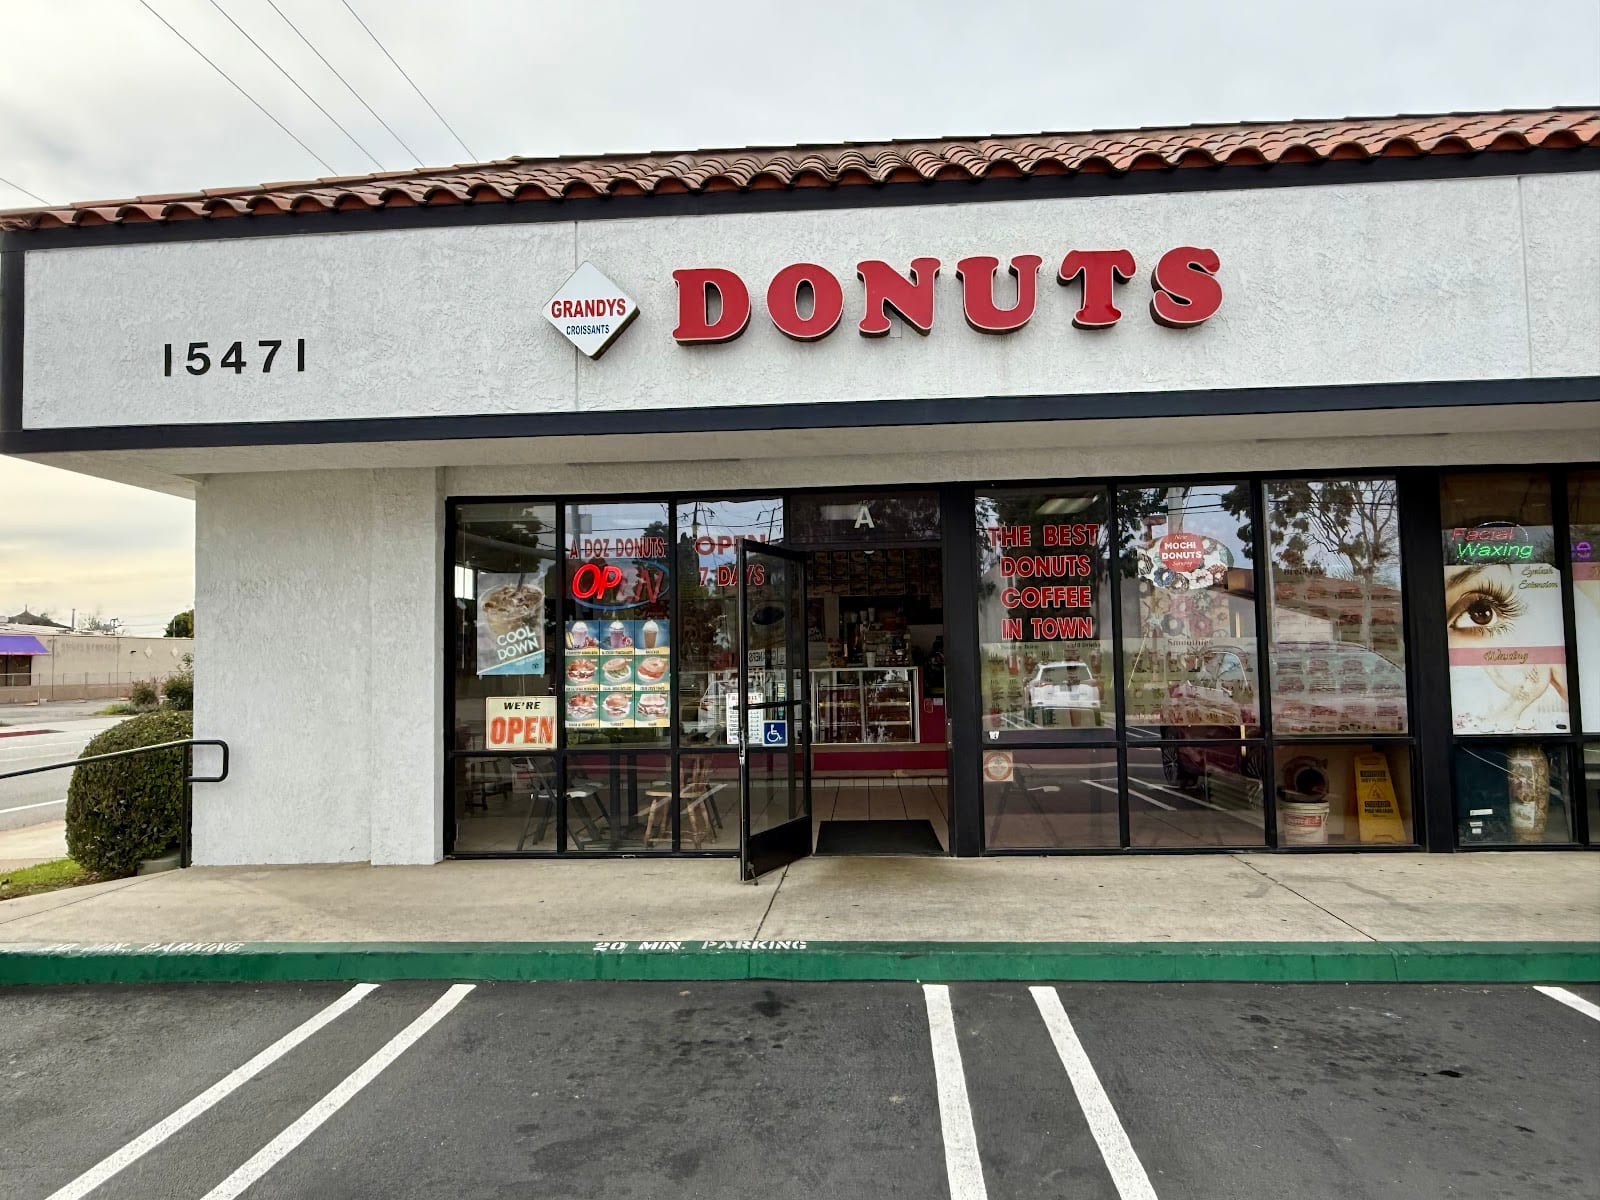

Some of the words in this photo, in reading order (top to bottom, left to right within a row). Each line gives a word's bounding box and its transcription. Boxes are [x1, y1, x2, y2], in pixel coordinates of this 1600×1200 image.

[671, 245, 1223, 344] DONUTS
[551, 298, 627, 319] GRANDYS
[566, 324, 610, 336] CROISSANTS
[164, 338, 305, 377] 15471
[854, 505, 875, 529] A
[988, 525, 1031, 547] THE
[1043, 524, 1099, 547] BEST
[1451, 527, 1515, 542] Facial
[584, 538, 609, 558] DOZ
[1161, 551, 1203, 560] DONUTS
[1164, 541, 1196, 550] MOCHI
[1456, 542, 1533, 559] Waxing
[698, 566, 709, 587] 7
[717, 564, 765, 587] DAYS
[1000, 555, 1091, 578] DONUTS
[1000, 586, 1091, 608] COFFEE
[496, 626, 536, 647] COOL
[1001, 618, 1022, 640] IN
[1031, 617, 1093, 640] TOWN
[497, 637, 539, 661] DOWN
[503, 701, 542, 711] WE'RE
[490, 715, 554, 745] OPEN
[138, 943, 244, 953] PARKING
[592, 941, 626, 951] 20
[701, 941, 807, 950] PARKING
